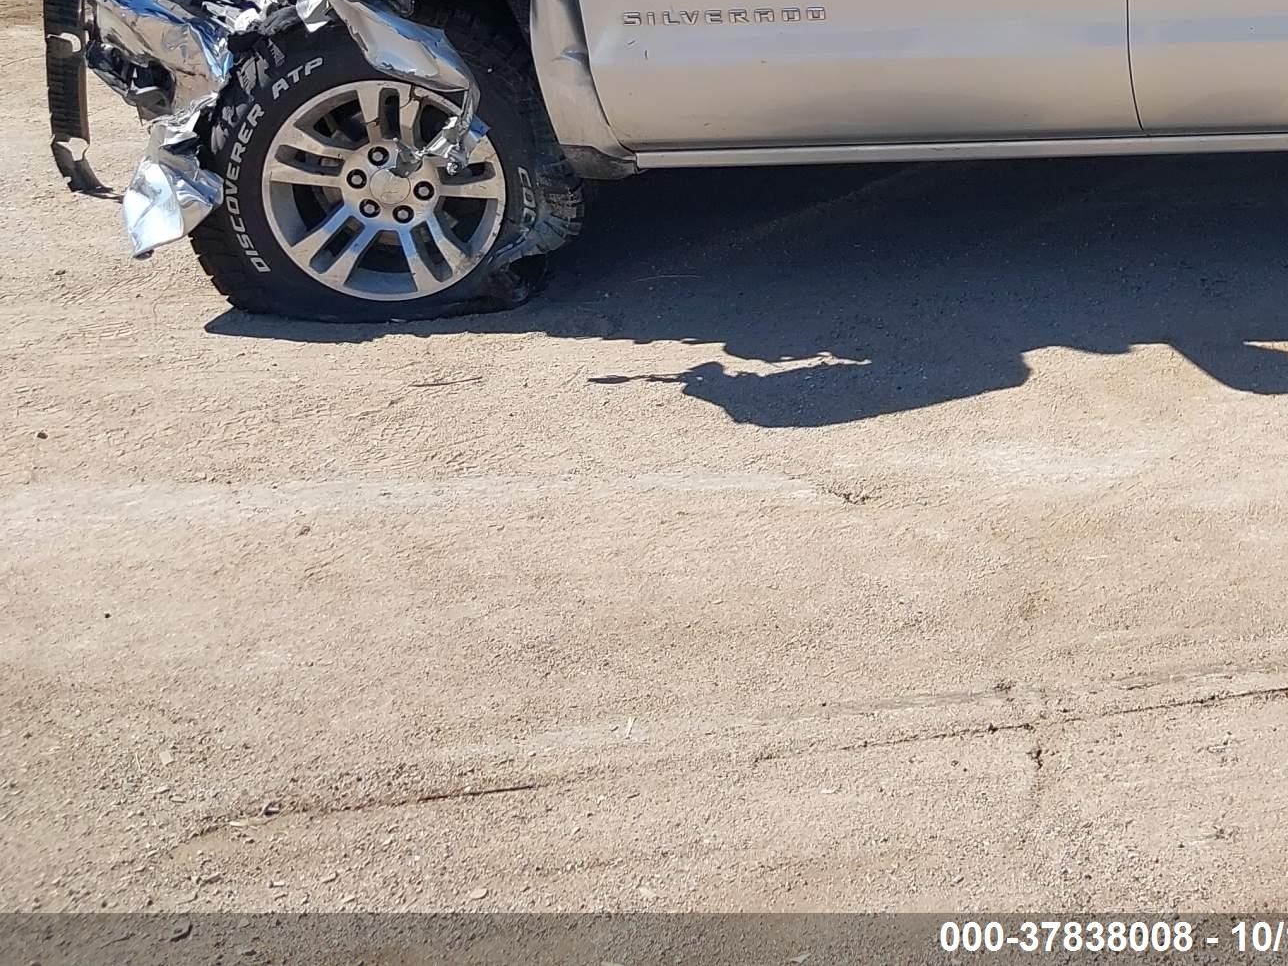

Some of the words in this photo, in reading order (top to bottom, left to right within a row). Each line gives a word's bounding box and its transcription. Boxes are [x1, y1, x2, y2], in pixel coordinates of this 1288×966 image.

[623, 6, 826, 26] SILVERADO
[224, 103, 271, 274] DISCOVERER
[272, 57, 324, 100] ATP
